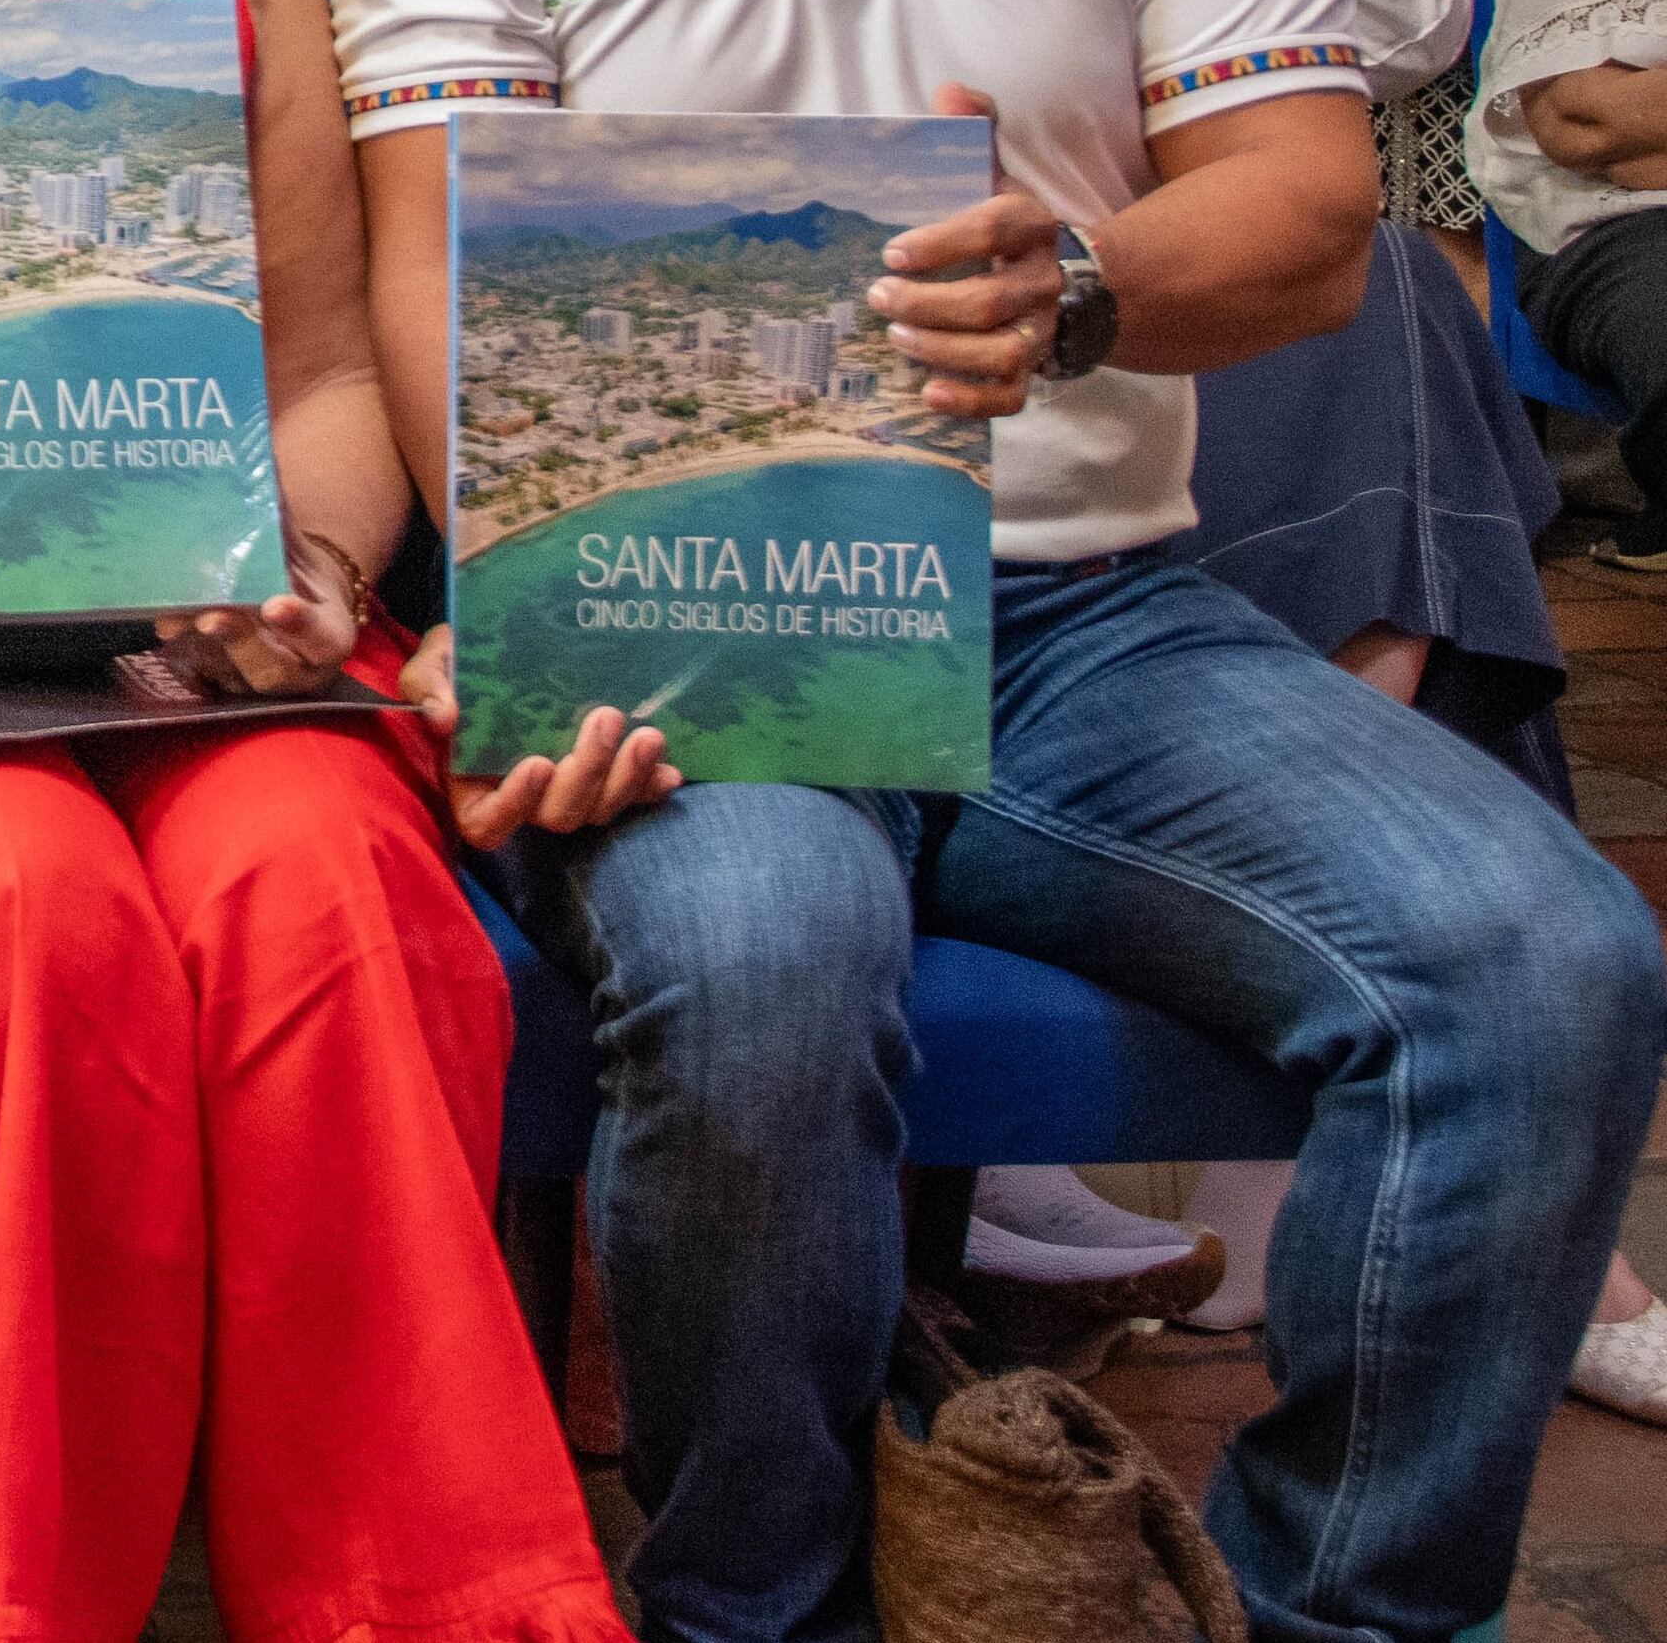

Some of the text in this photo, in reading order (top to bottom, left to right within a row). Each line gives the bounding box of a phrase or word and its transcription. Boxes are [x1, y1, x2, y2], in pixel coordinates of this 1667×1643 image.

[58, 377, 234, 431] MARTA
[71, 440, 106, 468] DE
[115, 439, 235, 467] HISTORIA
[576, 533, 952, 600] SANTA MARTA
[575, 598, 951, 640] CINCO SIGLOS DE HISTORIA
